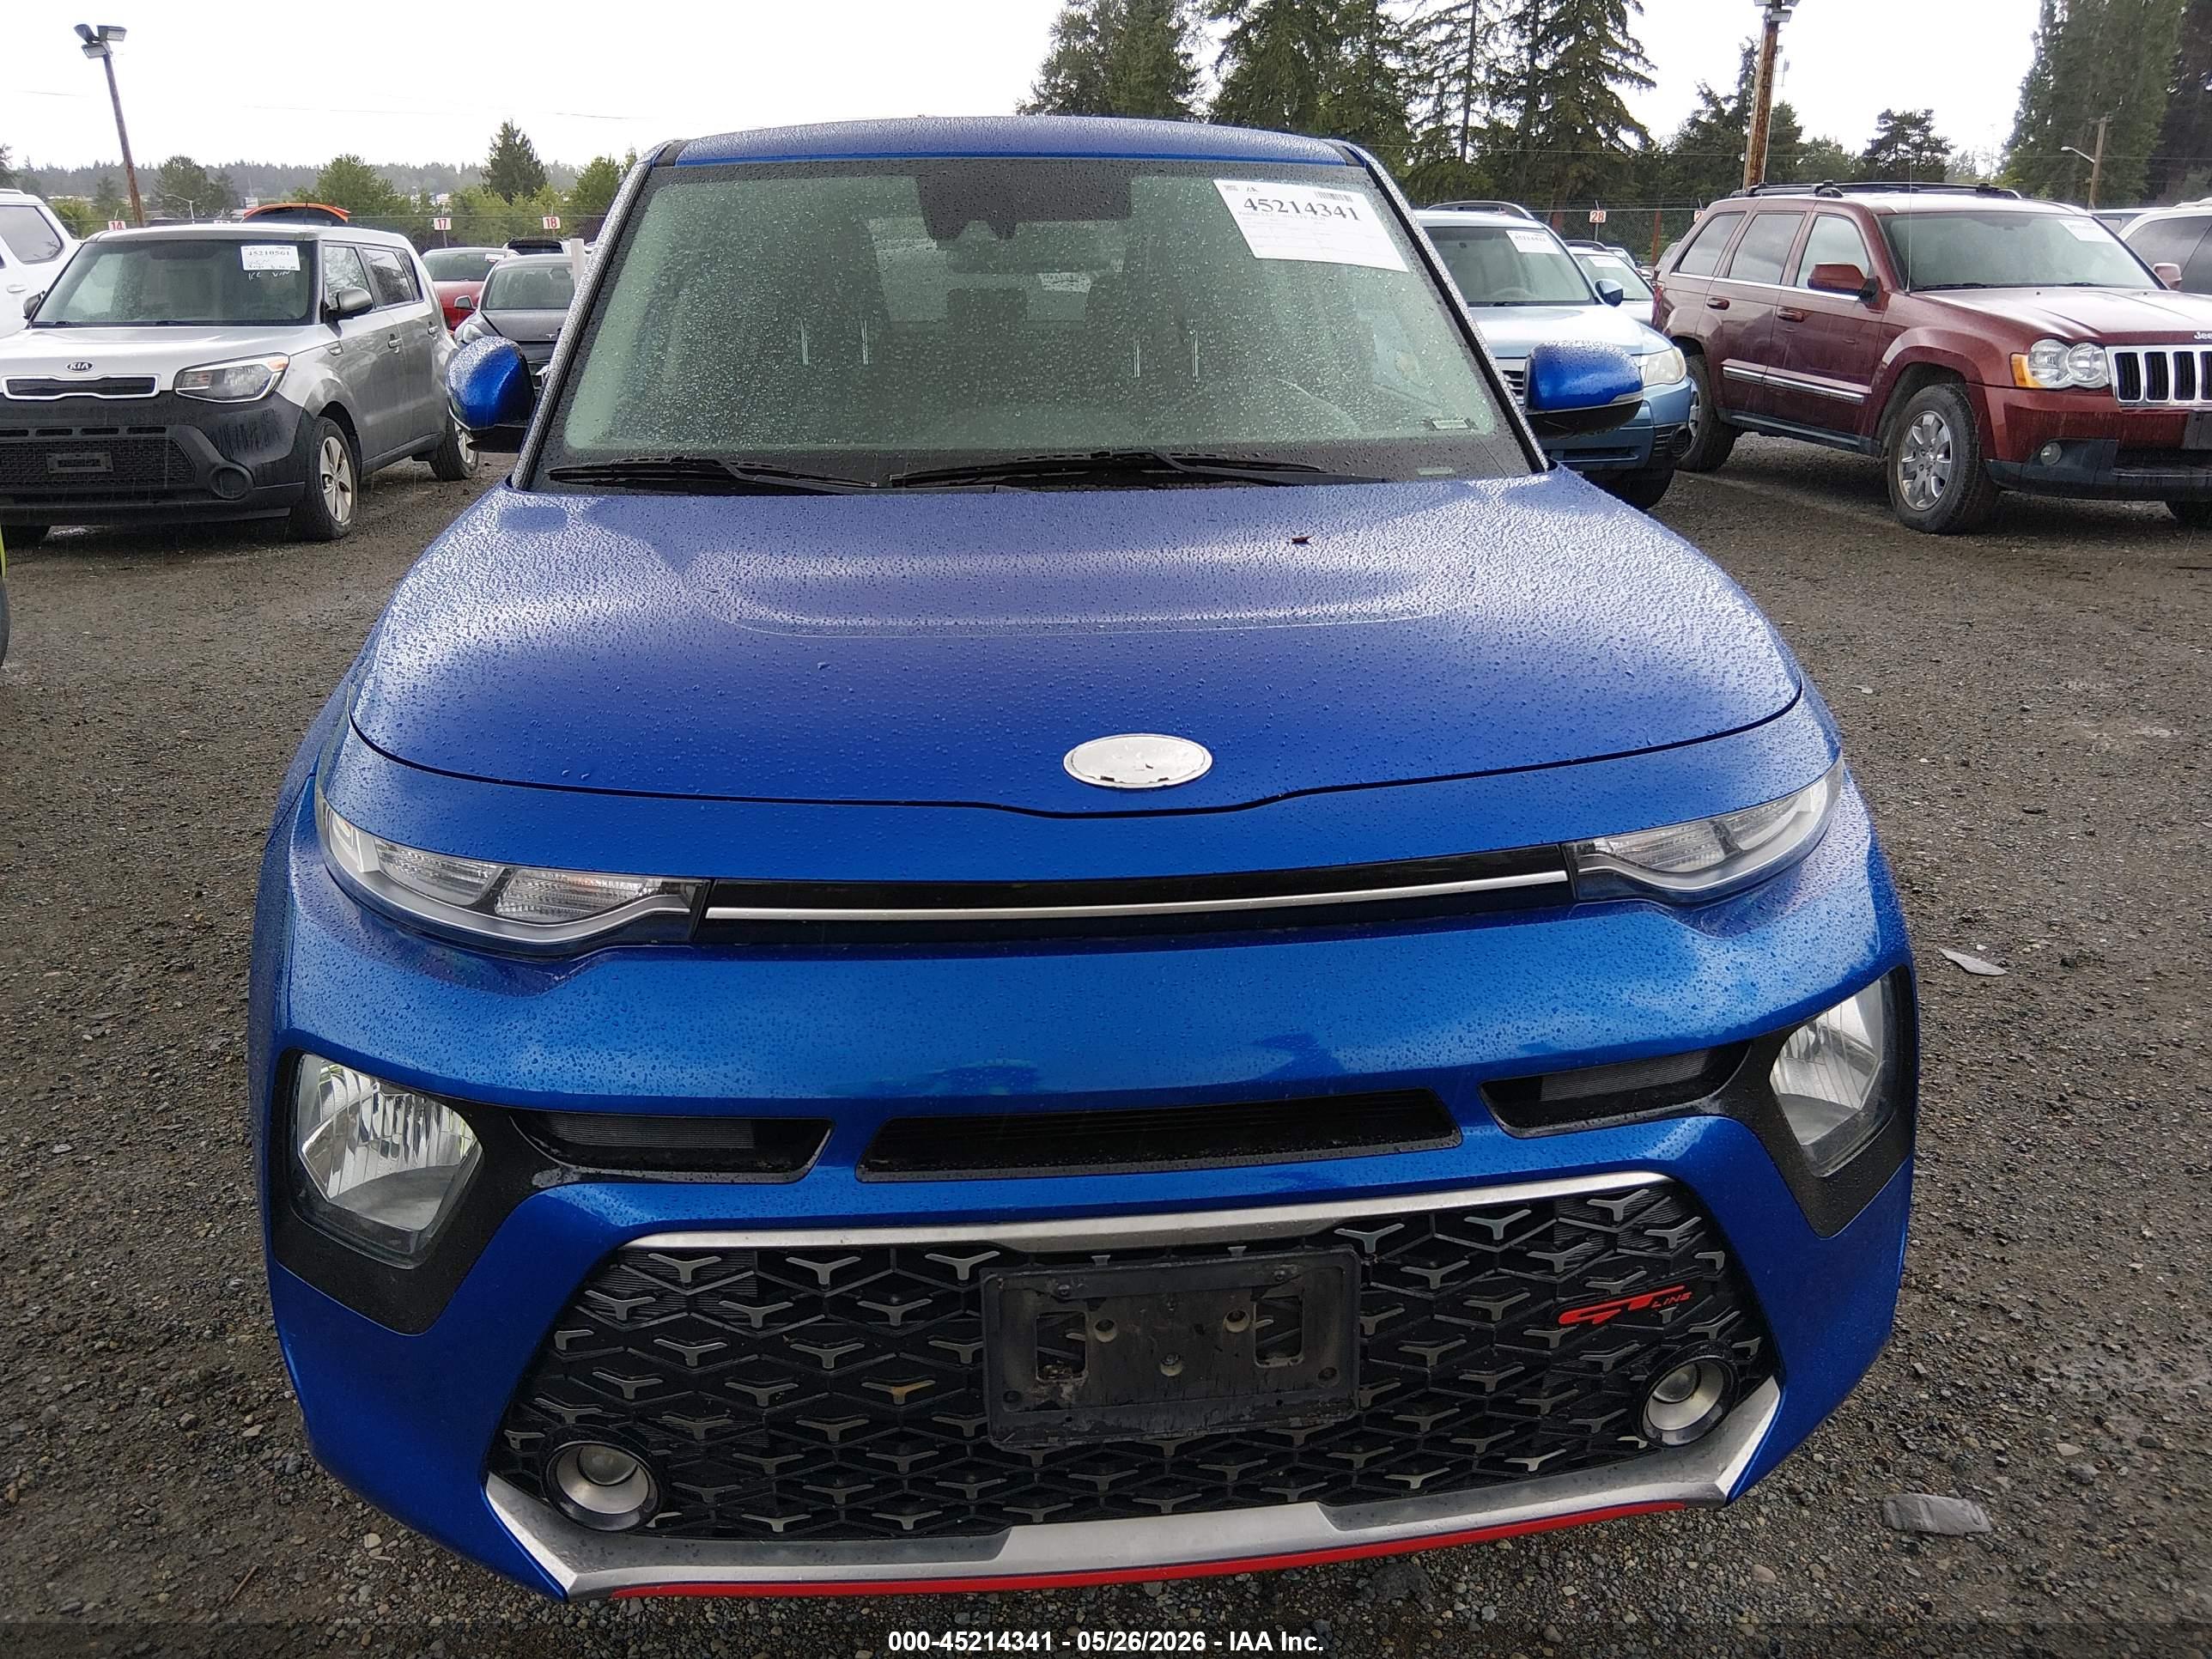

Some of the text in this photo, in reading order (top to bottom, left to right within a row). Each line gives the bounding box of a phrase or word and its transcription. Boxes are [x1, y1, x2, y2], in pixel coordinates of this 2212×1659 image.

[1243, 198, 1361, 221] 45214341
[1590, 211, 1604, 222] 28
[111, 222, 124, 230] 14
[437, 219, 447, 229] 17
[545, 217, 557, 228] 18
[1559, 1286, 1692, 1323] GT LINE
